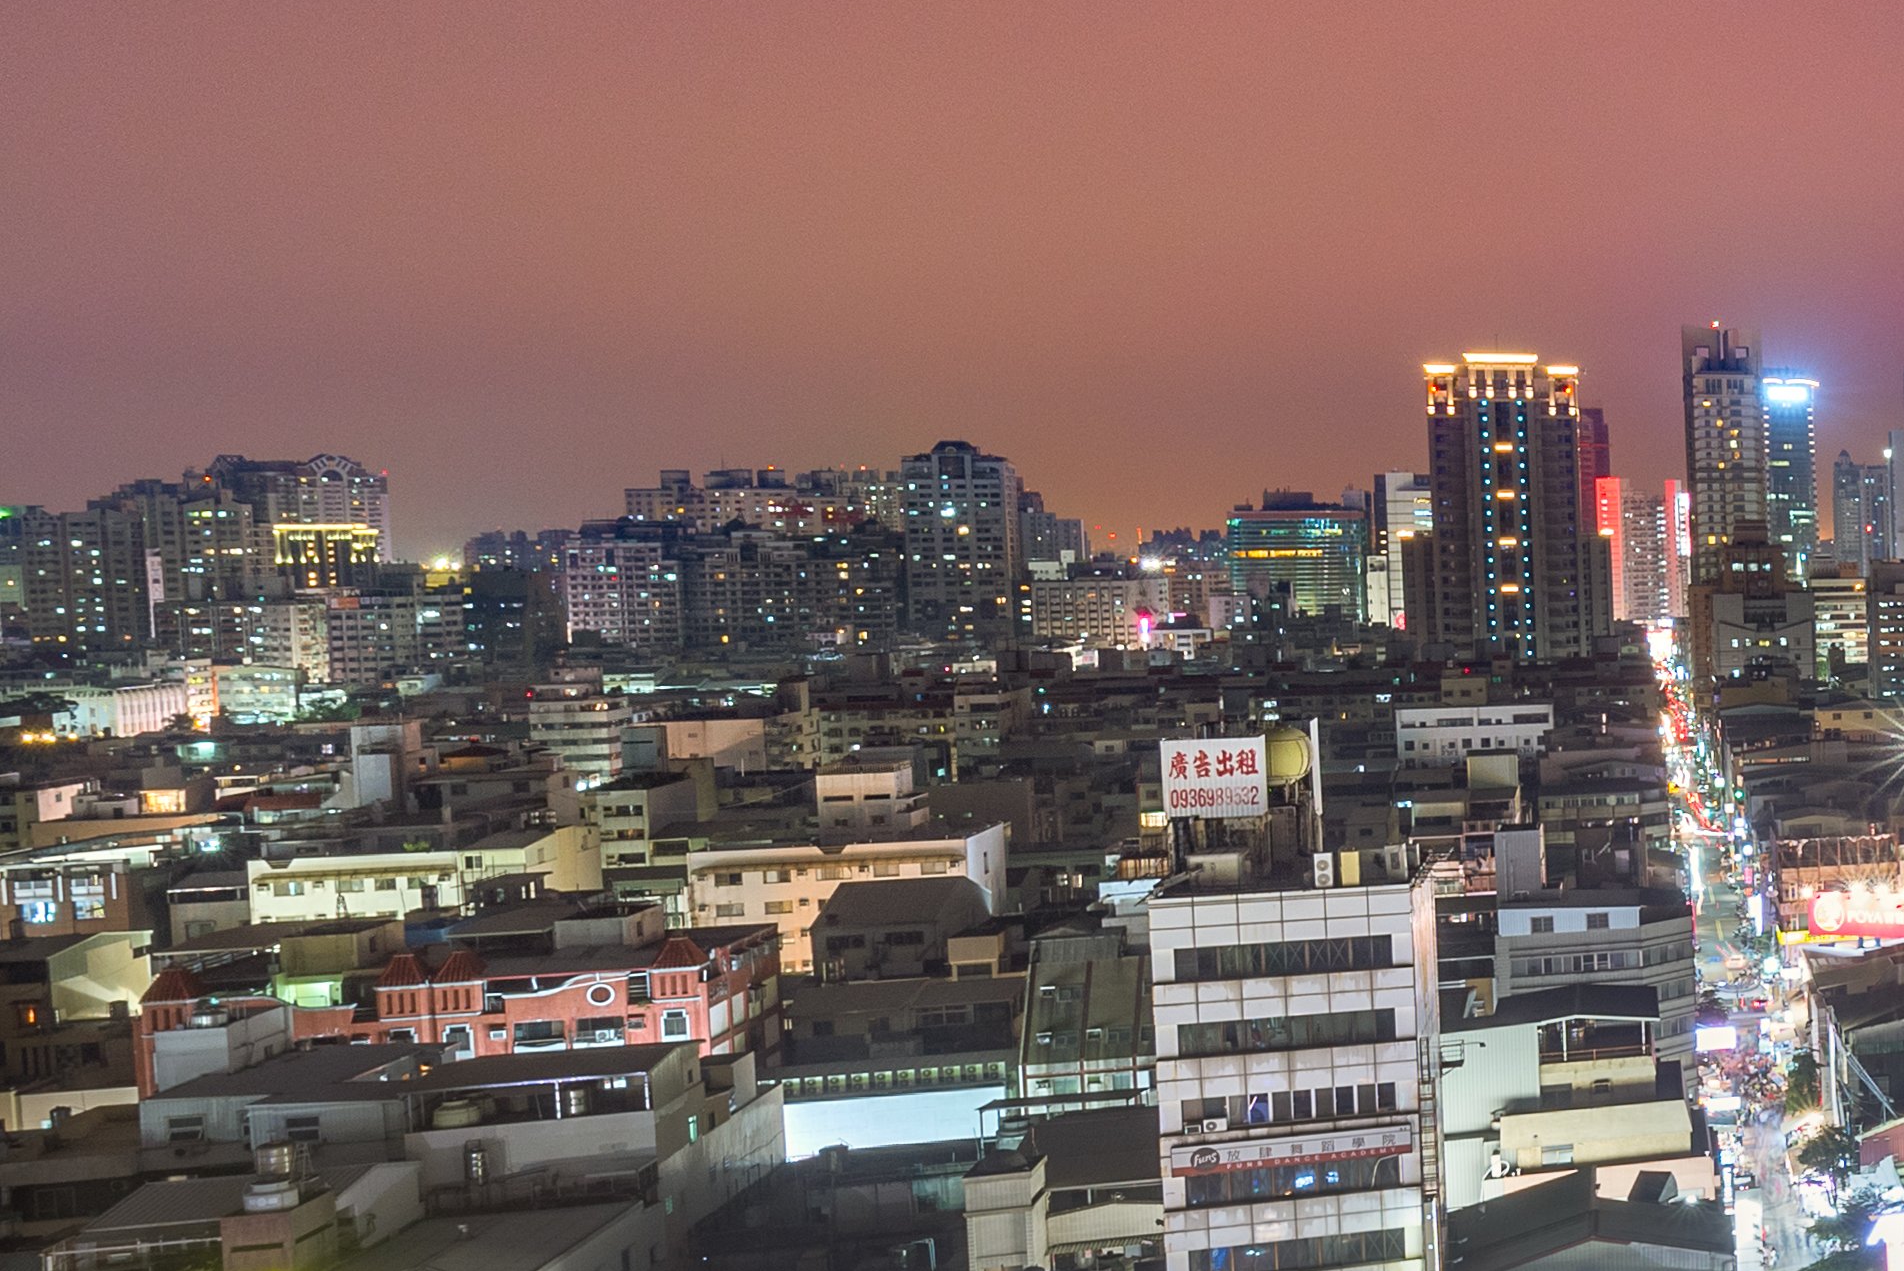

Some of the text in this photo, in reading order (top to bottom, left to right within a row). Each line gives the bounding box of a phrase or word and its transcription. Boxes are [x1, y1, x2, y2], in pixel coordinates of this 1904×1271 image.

[1168, 748, 1259, 780] 廣告出租
[1275, 1154, 1320, 1165] DANCE
[1331, 1147, 1397, 1159] ACADEMY
